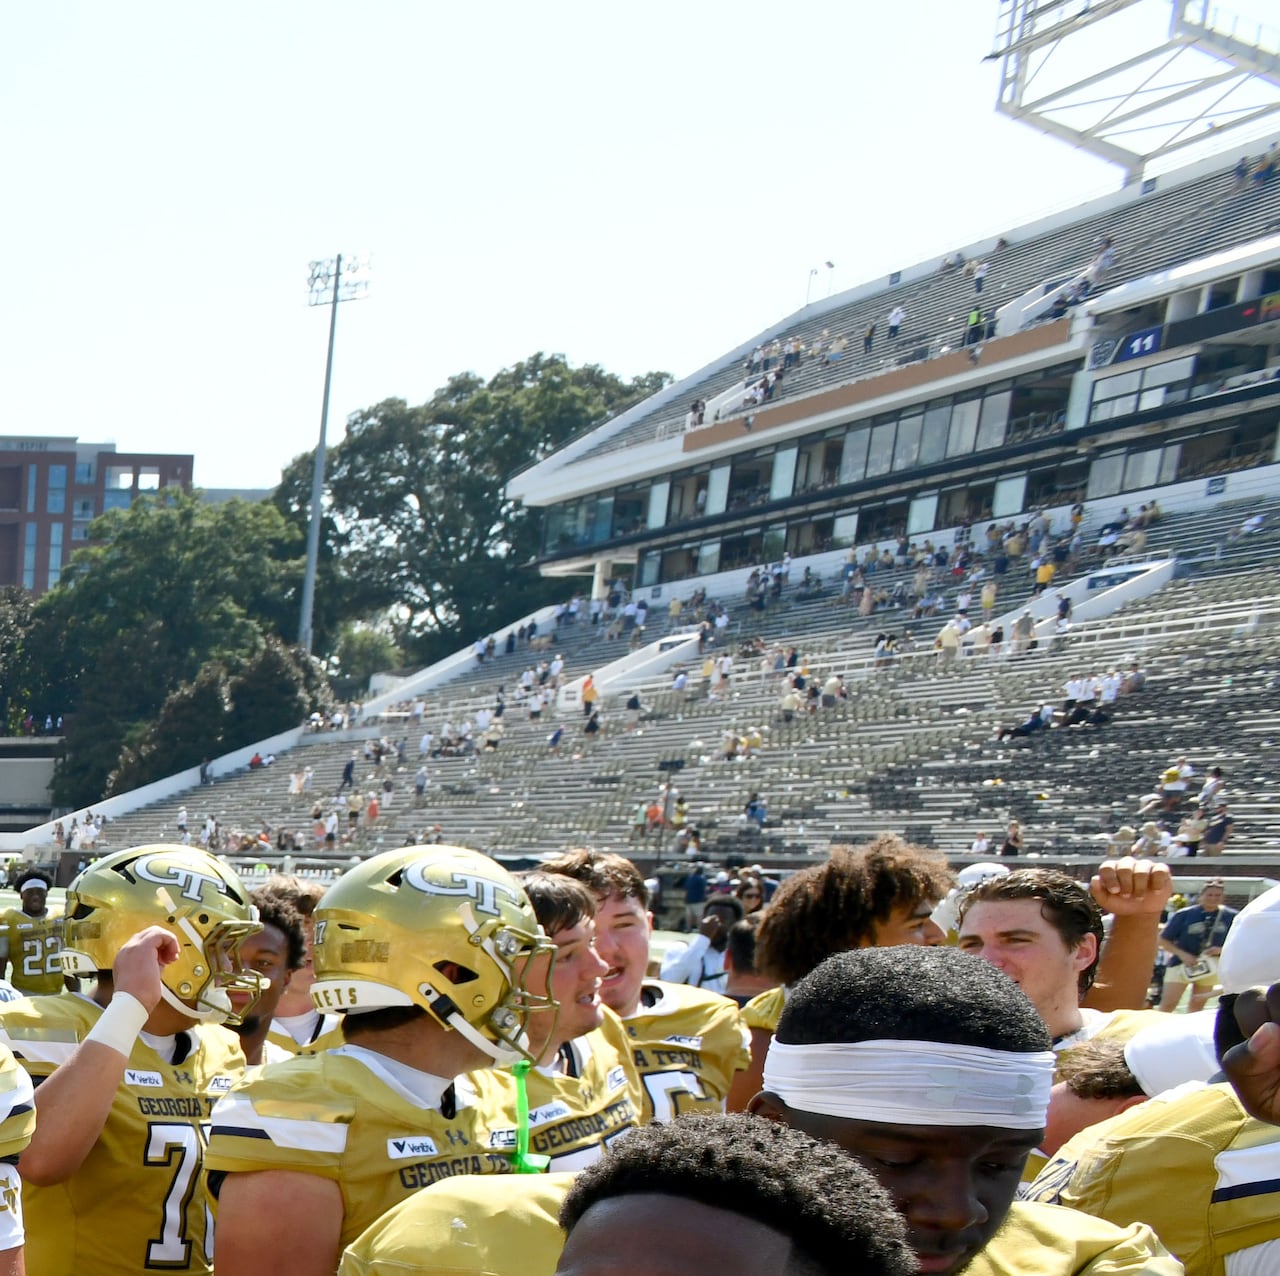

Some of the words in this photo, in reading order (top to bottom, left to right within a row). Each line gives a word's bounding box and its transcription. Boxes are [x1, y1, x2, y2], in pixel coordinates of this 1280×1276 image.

[1130, 335, 1154, 354] 11
[133, 853, 226, 902] GT
[405, 855, 520, 917] GT
[137, 1096, 203, 1118] GEORGIA
[531, 1112, 608, 1152] GEORGIA
[398, 1155, 482, 1190] GEORGIA
